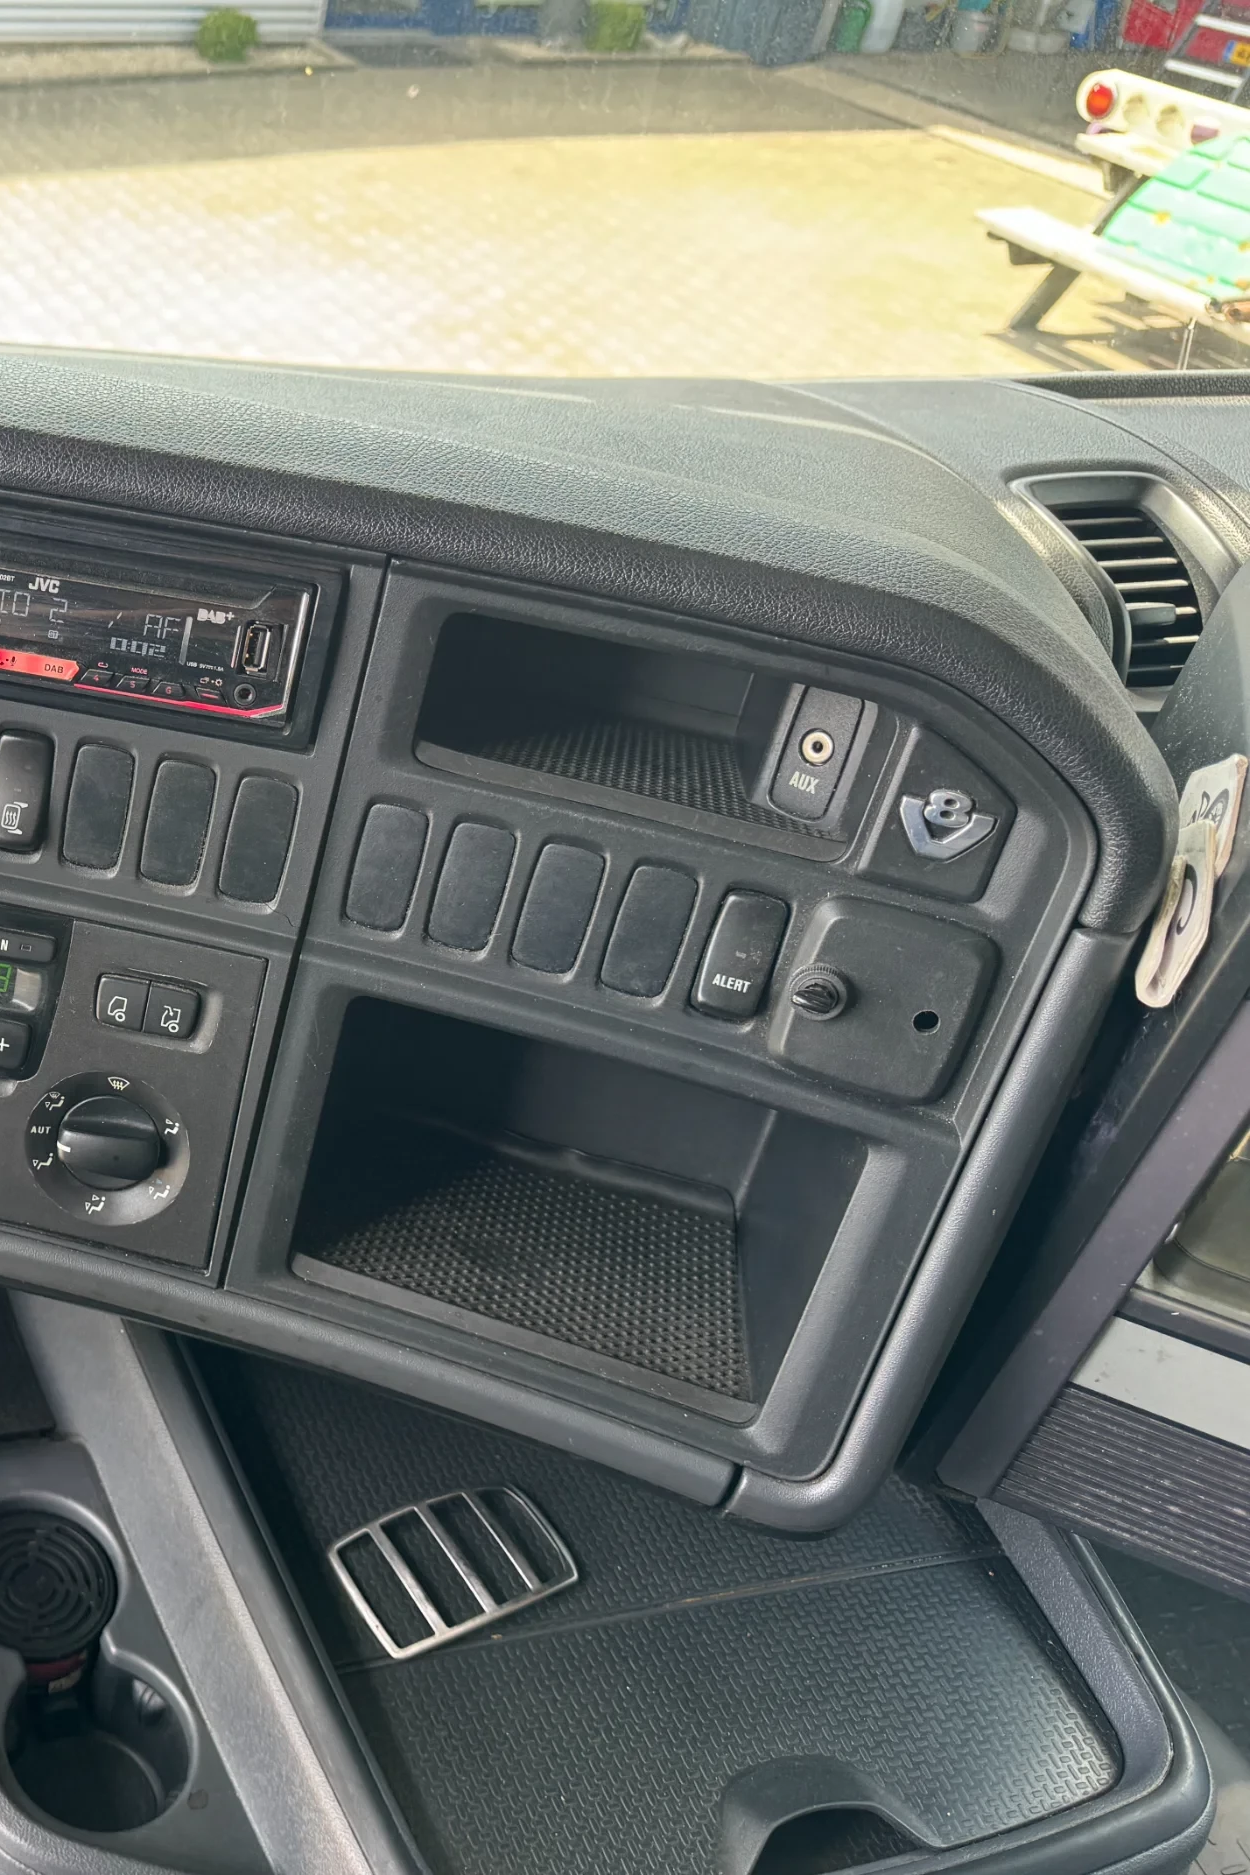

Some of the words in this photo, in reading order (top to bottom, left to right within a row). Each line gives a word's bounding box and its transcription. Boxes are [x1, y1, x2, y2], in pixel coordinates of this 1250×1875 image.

[28, 577, 61, 594] JVC
[49, 597, 68, 624] 2
[197, 608, 235, 625] DAB+
[44, 664, 64, 674] DAB
[789, 771, 819, 794] AUX
[712, 973, 751, 994] ALERT
[30, 1125, 51, 1134] AUT
